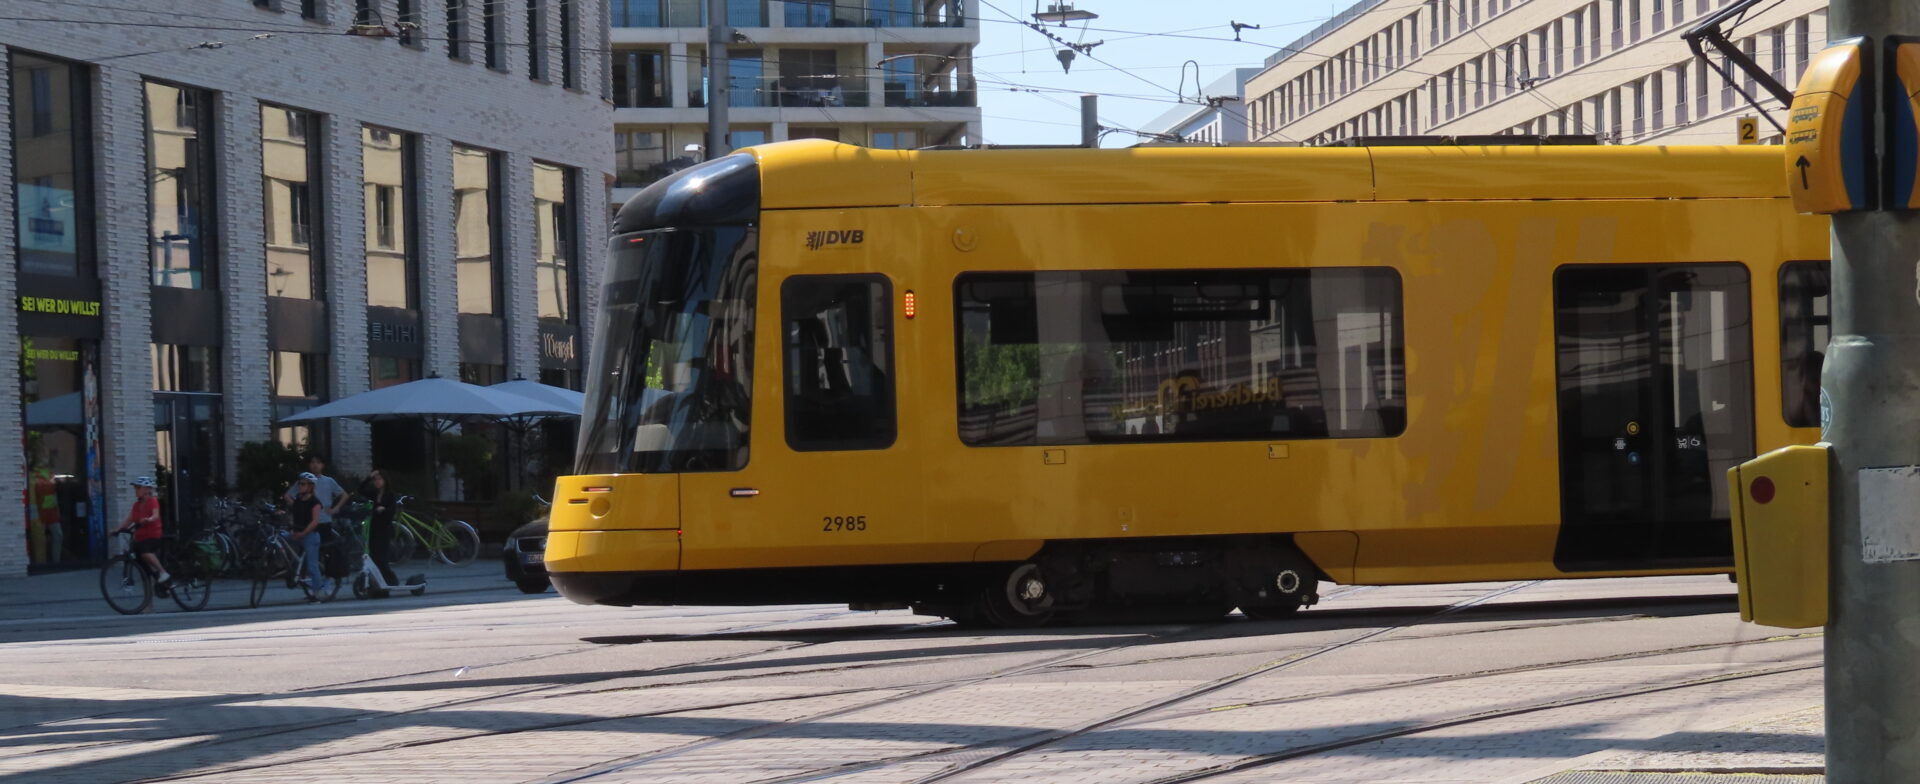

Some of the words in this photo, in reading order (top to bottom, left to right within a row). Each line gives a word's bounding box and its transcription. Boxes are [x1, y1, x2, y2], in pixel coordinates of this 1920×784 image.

[1742, 122, 1755, 140] 2
[826, 230, 865, 244] DVB
[22, 295, 35, 311] SEI
[36, 297, 56, 313] WER
[57, 299, 69, 314] DU
[70, 300, 100, 316] WILLST
[823, 515, 867, 531] 2985
